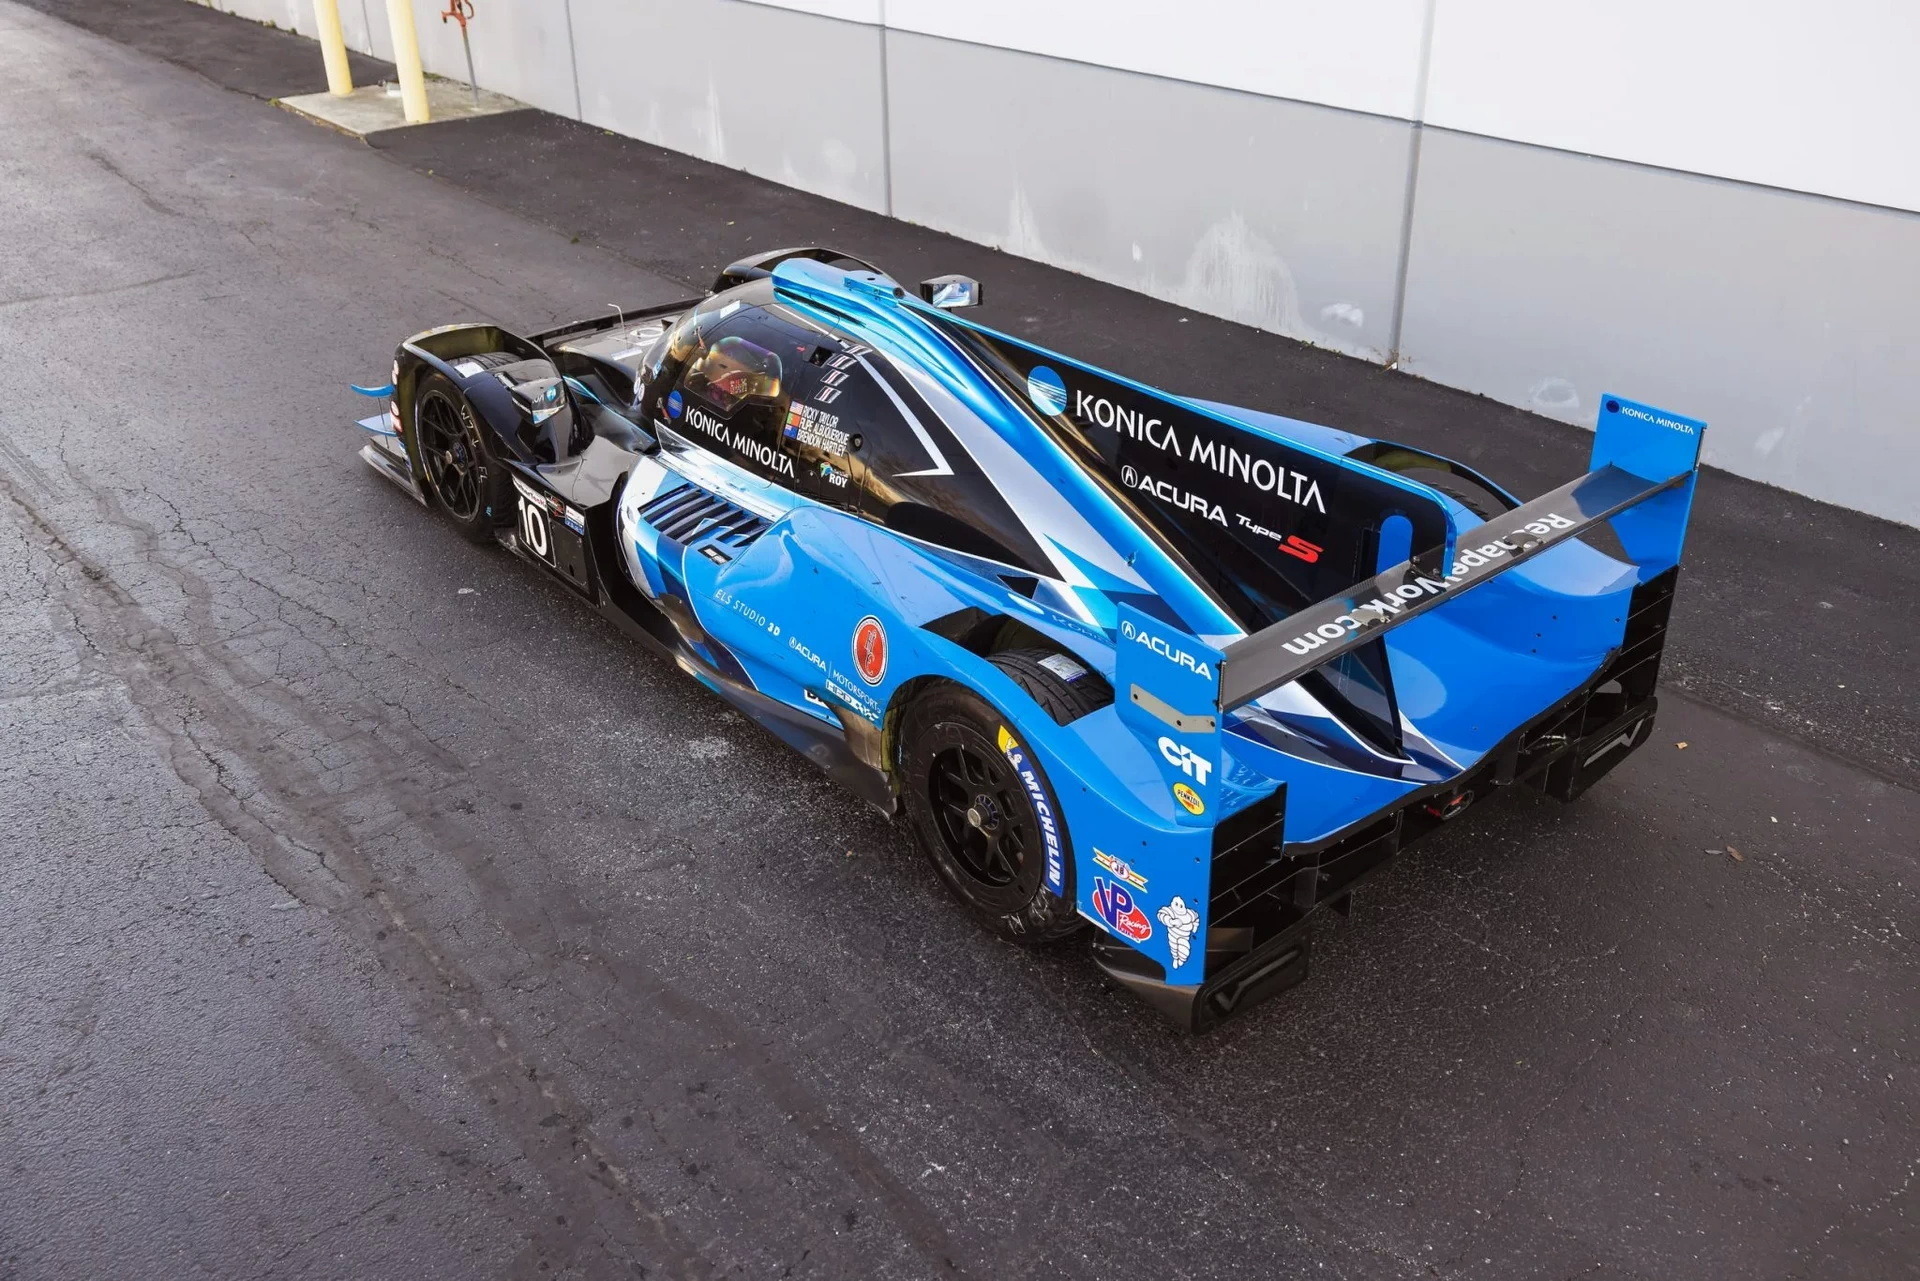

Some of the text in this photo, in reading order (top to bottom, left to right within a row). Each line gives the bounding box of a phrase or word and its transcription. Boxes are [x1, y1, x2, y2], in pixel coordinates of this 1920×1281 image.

[685, 405, 795, 478] KONICA MINOLTA
[802, 405, 839, 429] RICKY TAYLOR
[813, 422, 850, 446] ALBUQUERQUE
[1622, 406, 1695, 435] KONICA MINOLTA
[796, 429, 847, 458] BRENDON HARTLEY
[1076, 389, 1327, 514] KONICA MINOLTA
[828, 473, 848, 488] ROY
[518, 495, 548, 556] 10
[1138, 475, 1229, 528] ACURA
[1278, 535, 1324, 564] S
[1281, 513, 1577, 655] RehapeWorkcom
[715, 589, 781, 637] ELS STUDIO 3D
[794, 642, 827, 672] ACURA
[833, 669, 878, 710] MOTORSPORT
[1135, 631, 1213, 681] ACURA
[1021, 770, 1061, 886] MICHELIN
[1094, 877, 1134, 928] VP
